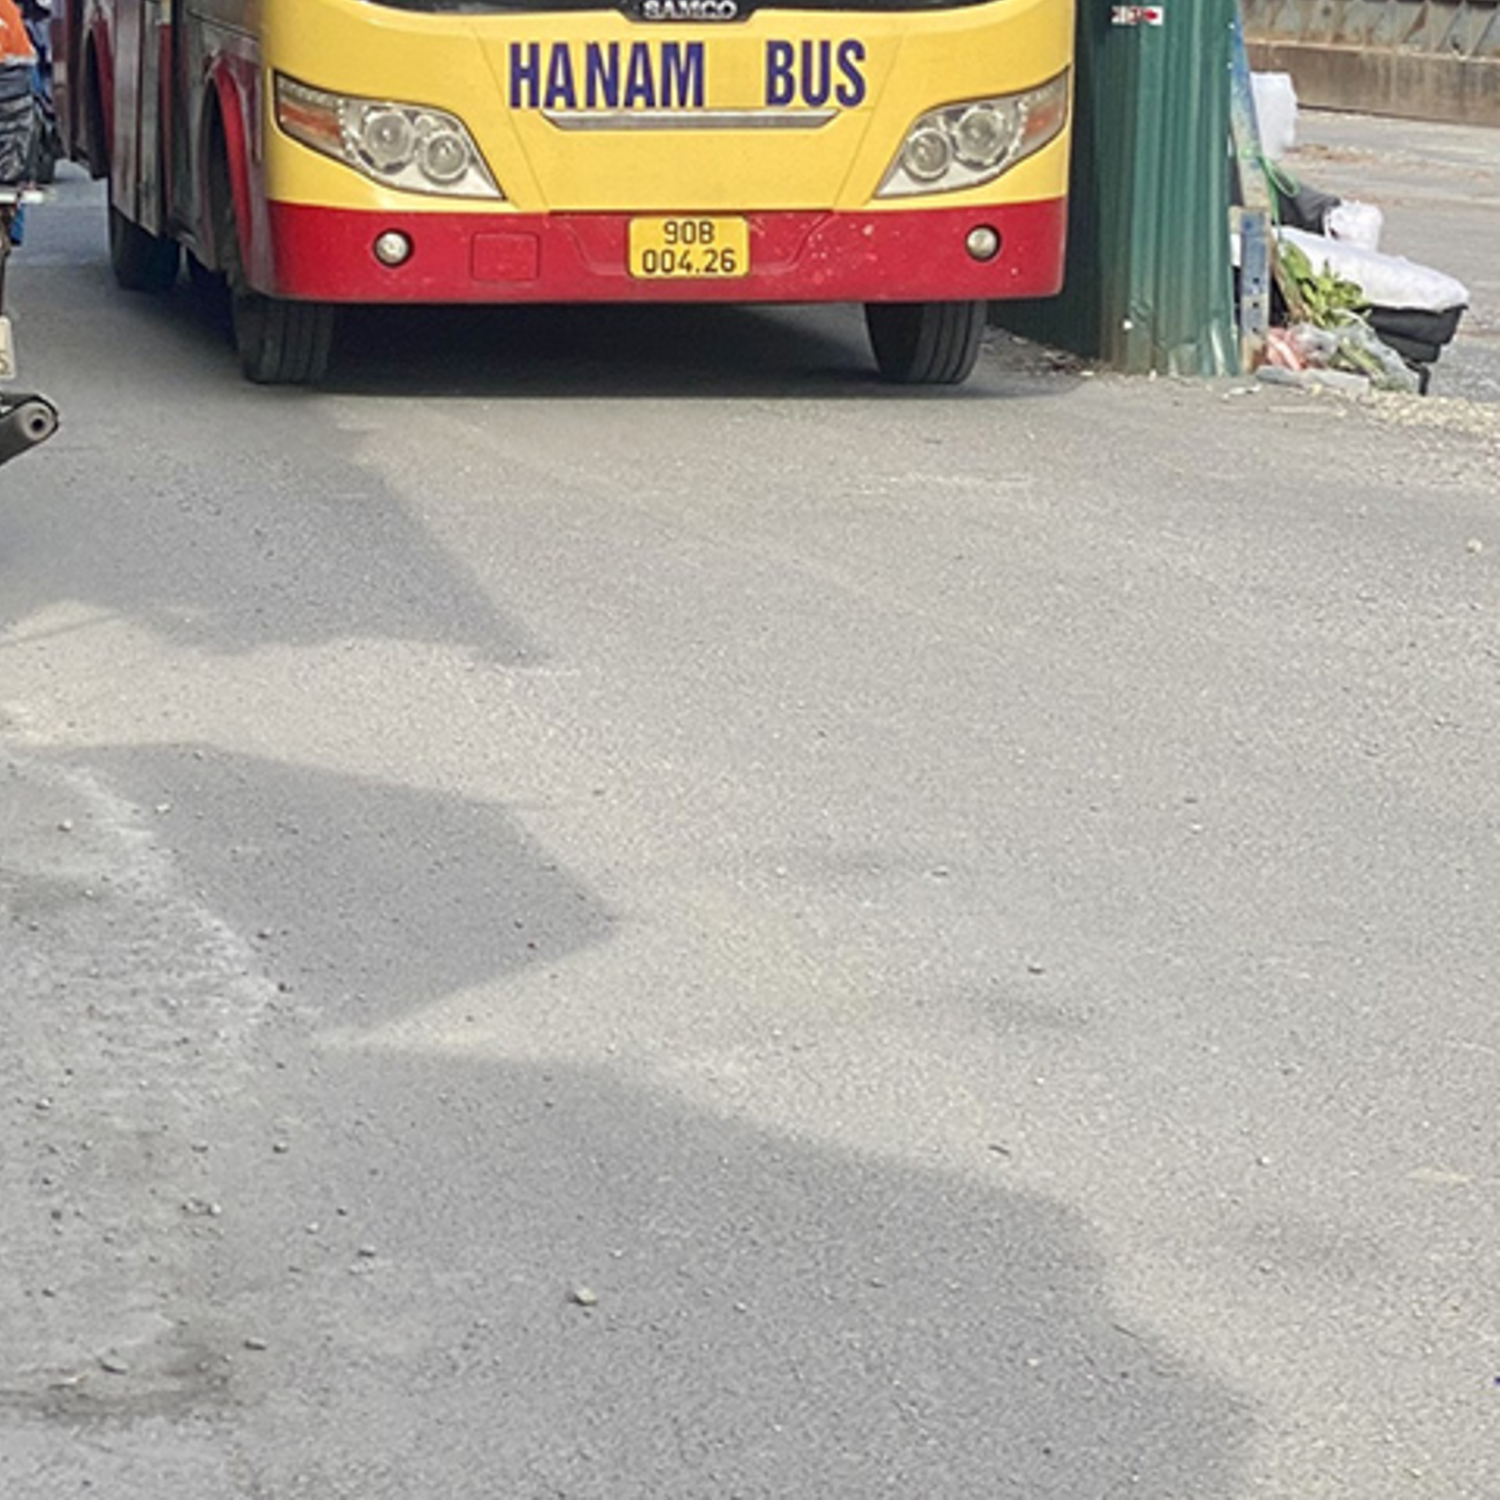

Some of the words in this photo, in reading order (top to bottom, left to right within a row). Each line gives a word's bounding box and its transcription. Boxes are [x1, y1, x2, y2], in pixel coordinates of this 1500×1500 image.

[642, 0, 739, 20] SAMCO
[508, 41, 706, 109] HANAM
[764, 39, 867, 109] BUS
[663, 220, 715, 245] 90B
[641, 248, 737, 274] 004.26
